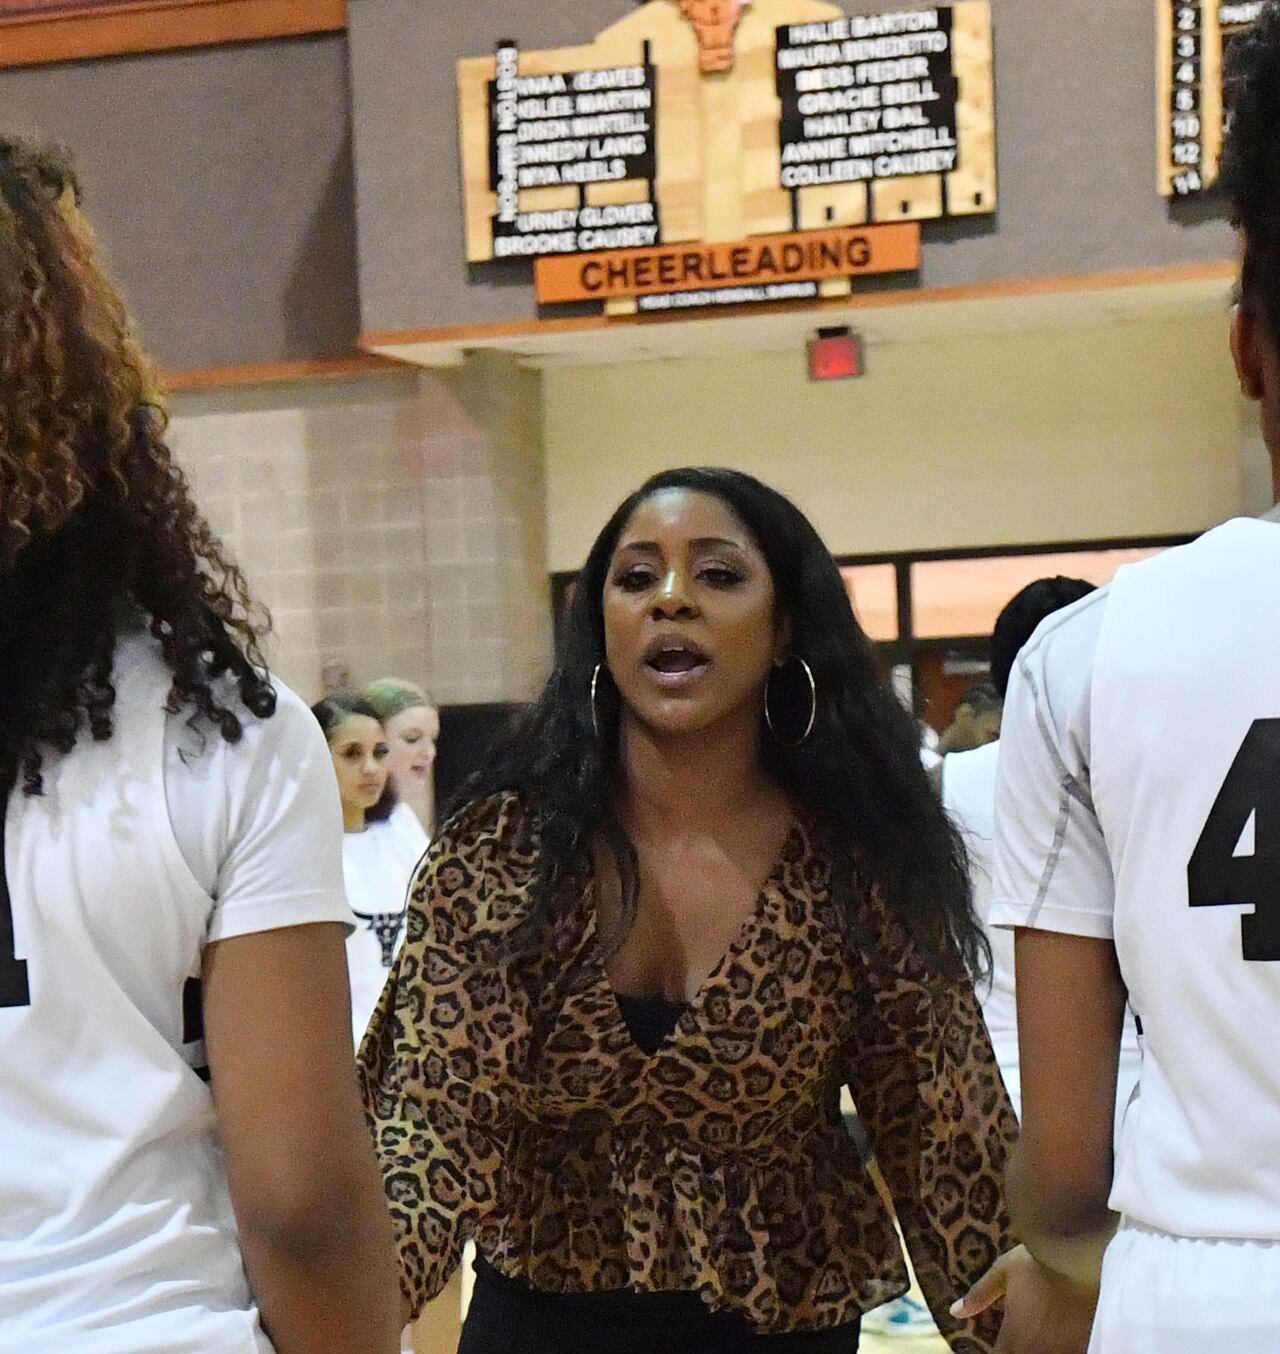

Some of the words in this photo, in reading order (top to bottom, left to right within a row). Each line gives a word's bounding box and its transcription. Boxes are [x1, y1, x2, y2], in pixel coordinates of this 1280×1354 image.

[1177, 7, 1195, 30] 2
[1177, 34, 1195, 57] 3
[1176, 61, 1195, 83] 4
[798, 85, 881, 115] GRACIE
[590, 134, 647, 159] LANG
[782, 137, 848, 163] ANNIE
[1173, 142, 1199, 164] 12
[781, 158, 873, 187] COLLEEN
[494, 231, 577, 257] BROOKE
[580, 236, 871, 290] CHEERLEADING
